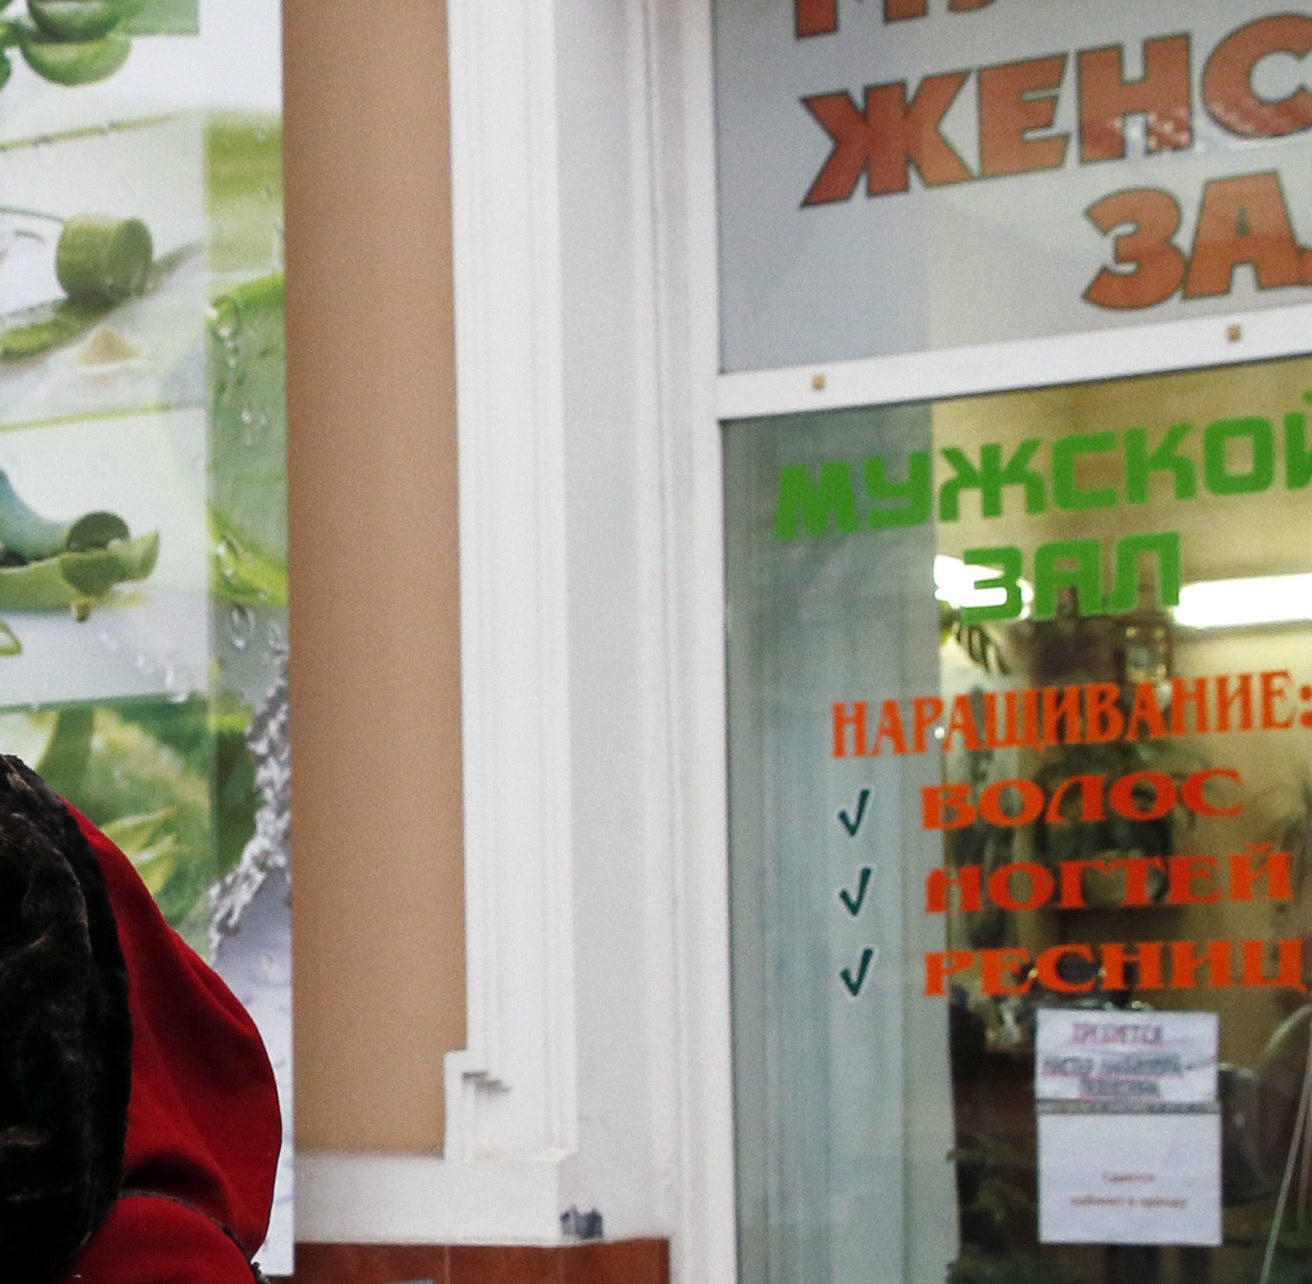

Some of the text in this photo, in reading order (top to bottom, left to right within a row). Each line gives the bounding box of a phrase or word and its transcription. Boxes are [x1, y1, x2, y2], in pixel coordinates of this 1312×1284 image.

[1081, 169, 1312, 311] ЗА
[961, 531, 1180, 625] ЗАЛ
[919, 768, 1244, 829] ВОЛОС
[924, 841, 1293, 914] НОГТЕЙ
[923, 938, 1309, 996] РЕСНИЦ
